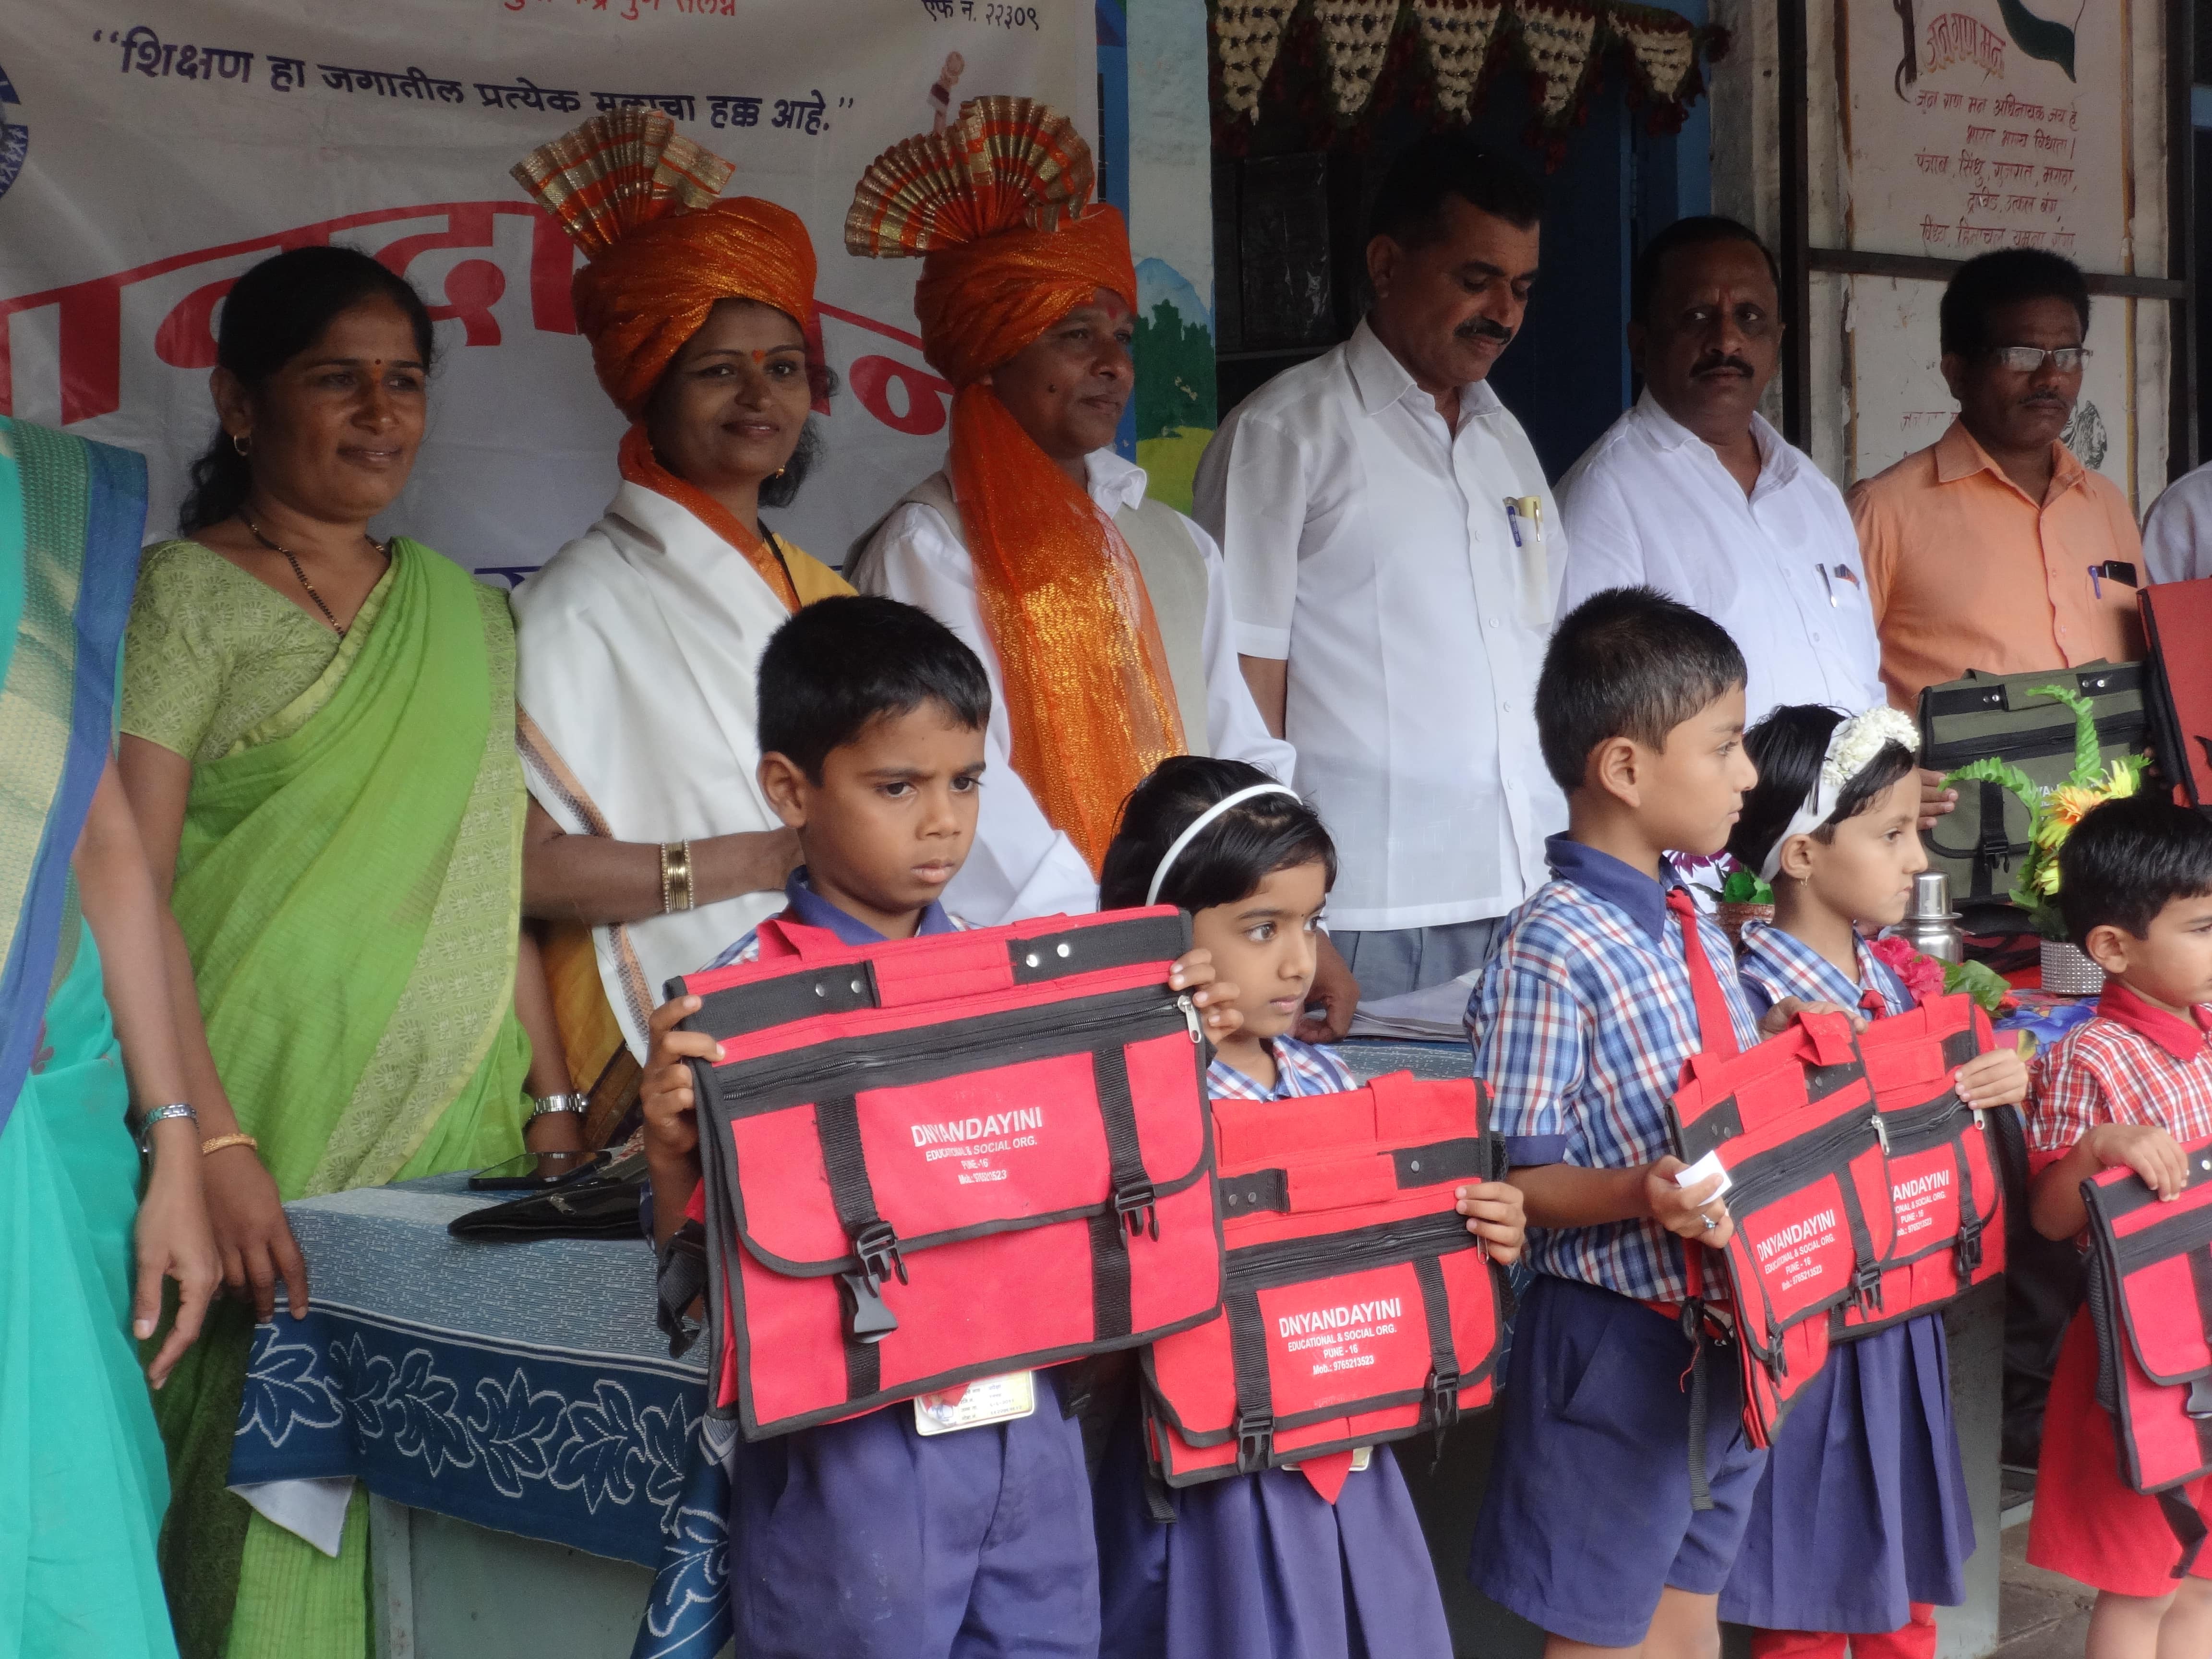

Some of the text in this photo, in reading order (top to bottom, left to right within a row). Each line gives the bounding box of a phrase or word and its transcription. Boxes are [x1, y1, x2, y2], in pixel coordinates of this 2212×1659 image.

[986, 3, 1039, 31] २२३०९
[266, 55, 306, 92] हा
[317, 64, 464, 104] जगातील
[473, 77, 580, 113] प्रत्येक
[706, 96, 762, 129] हक्क
[911, 1106, 1042, 1147] DNYANDAYINI
[973, 1141, 1011, 1155] SOCIAL
[1012, 1136, 1037, 1148] ORG.
[1891, 1170, 1949, 1202] ANDAYINI
[1915, 1195, 1933, 1207] SOCIAL
[1933, 1191, 1946, 1201] ORG.
[1901, 1213, 1915, 1224] PUNE
[1757, 1209, 1836, 1262] DNYANDAYINI
[1765, 1233, 1835, 1274] EDUCATIONAL & SOCIAL ORG.
[1786, 1261, 1800, 1275] PUNE
[1803, 1257, 1811, 1266] 16
[1278, 1298, 1401, 1338] DNYANDAYINI
[1288, 1324, 1397, 1352] EDUCATIONAL & SOCIAL ORG.
[1323, 1347, 1344, 1358] PUNE
[1349, 1344, 1358, 1354] 16
[1334, 1355, 1374, 1371] 9765213523
